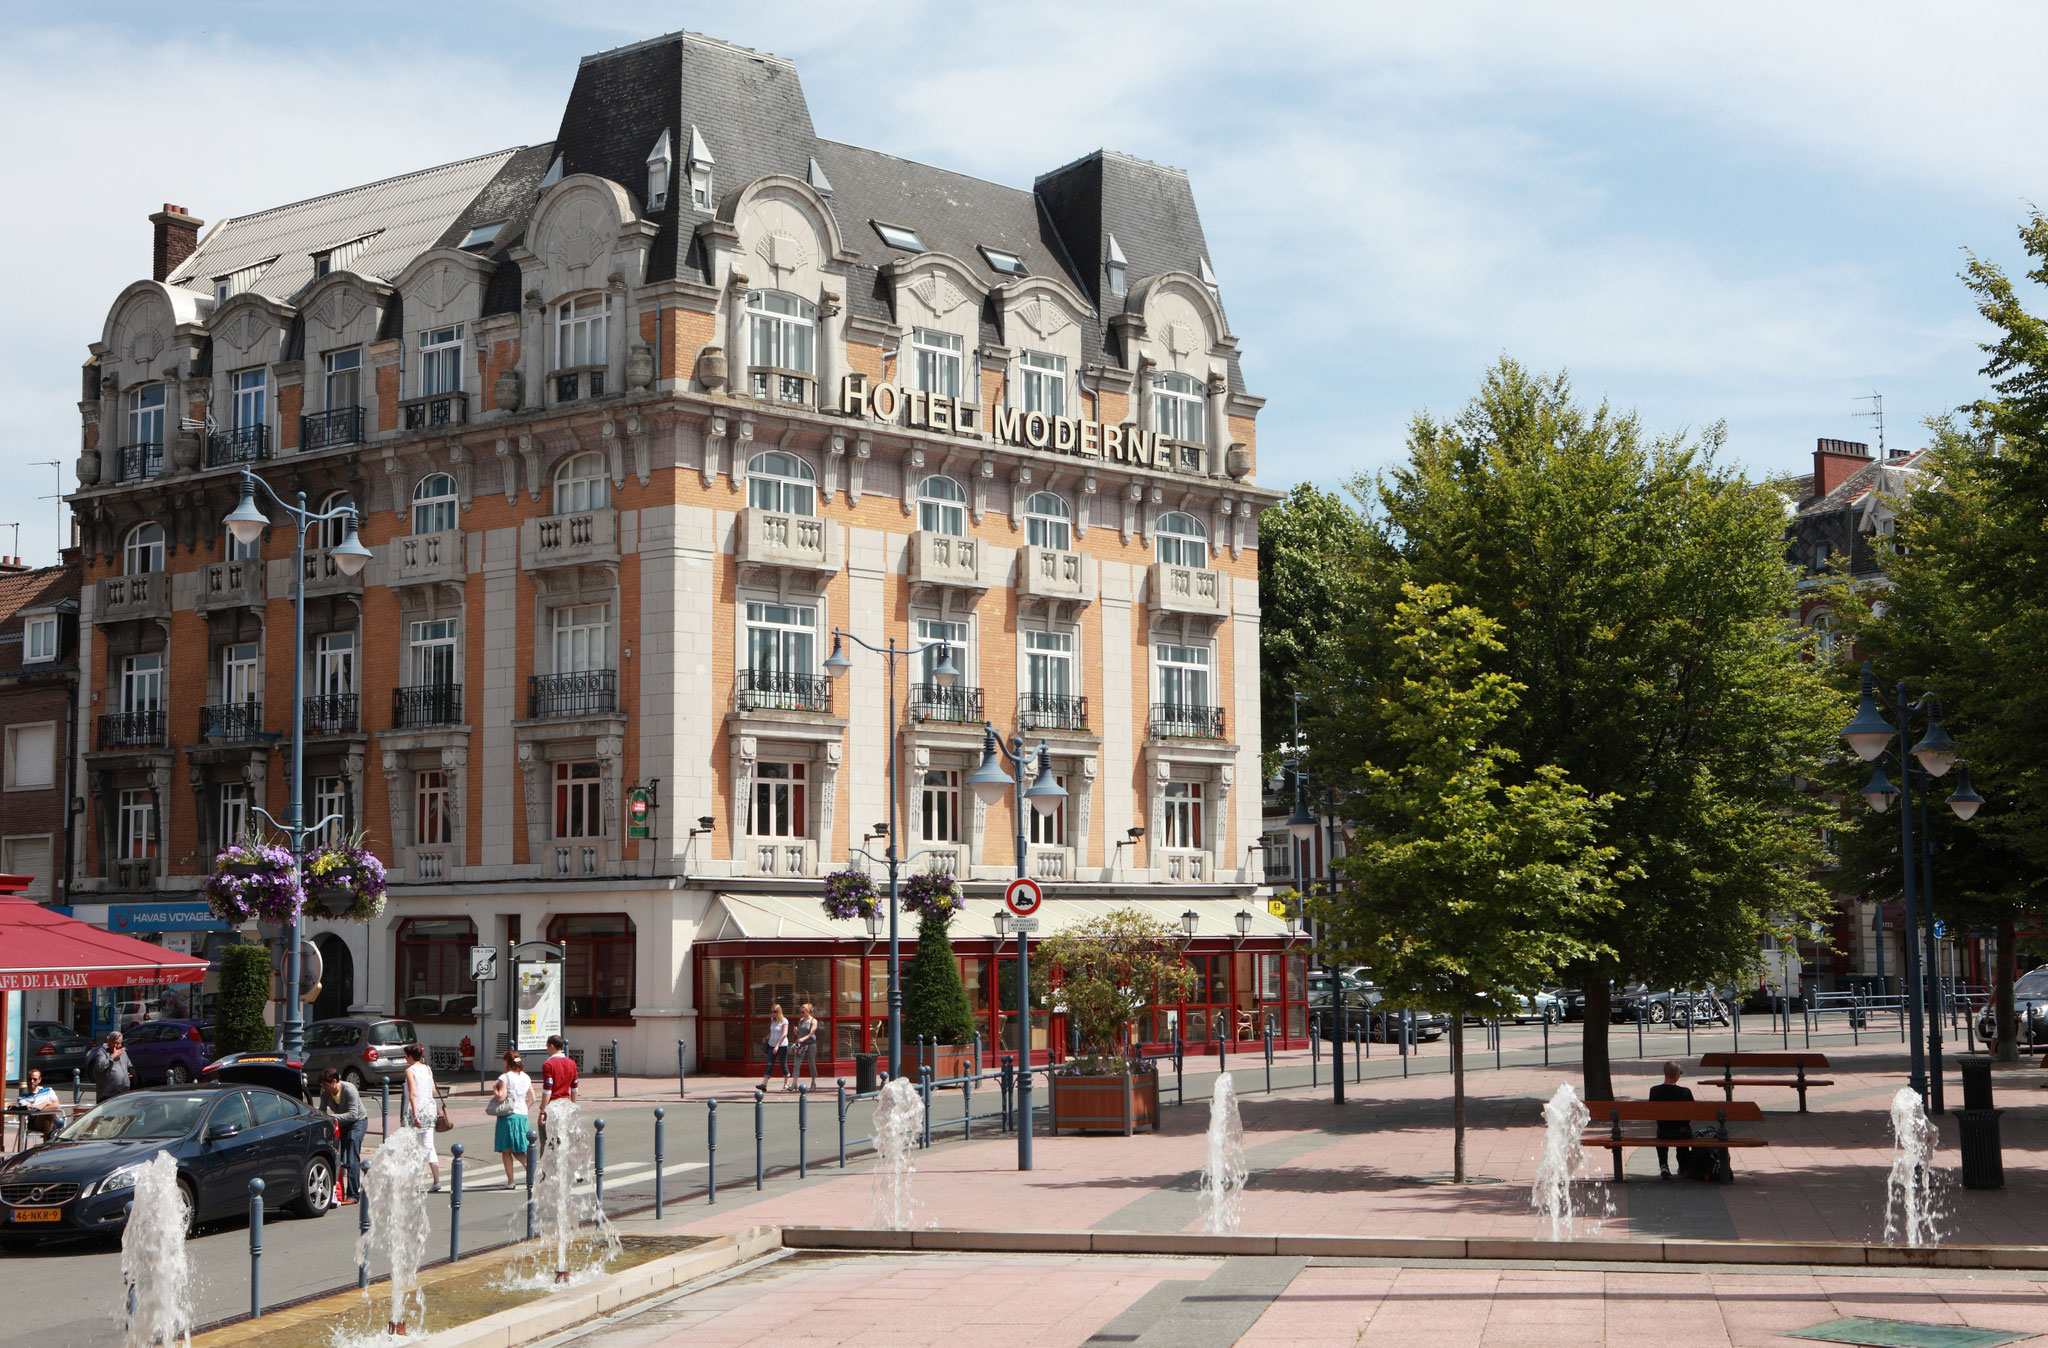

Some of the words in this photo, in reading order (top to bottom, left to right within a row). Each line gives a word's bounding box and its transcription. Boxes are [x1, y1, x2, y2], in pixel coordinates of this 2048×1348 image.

[843, 375, 976, 435] HOTEL
[993, 404, 1173, 468] MODERNE
[133, 912, 167, 923] HAVAS
[22, 974, 41, 988] DE
[43, 974, 61, 987] LA
[62, 973, 88, 986] PAIX
[126, 976, 137, 985] Bar
[138, 975, 165, 984] Brasserie
[16, 1210, 58, 1221] 46-NKR-9
